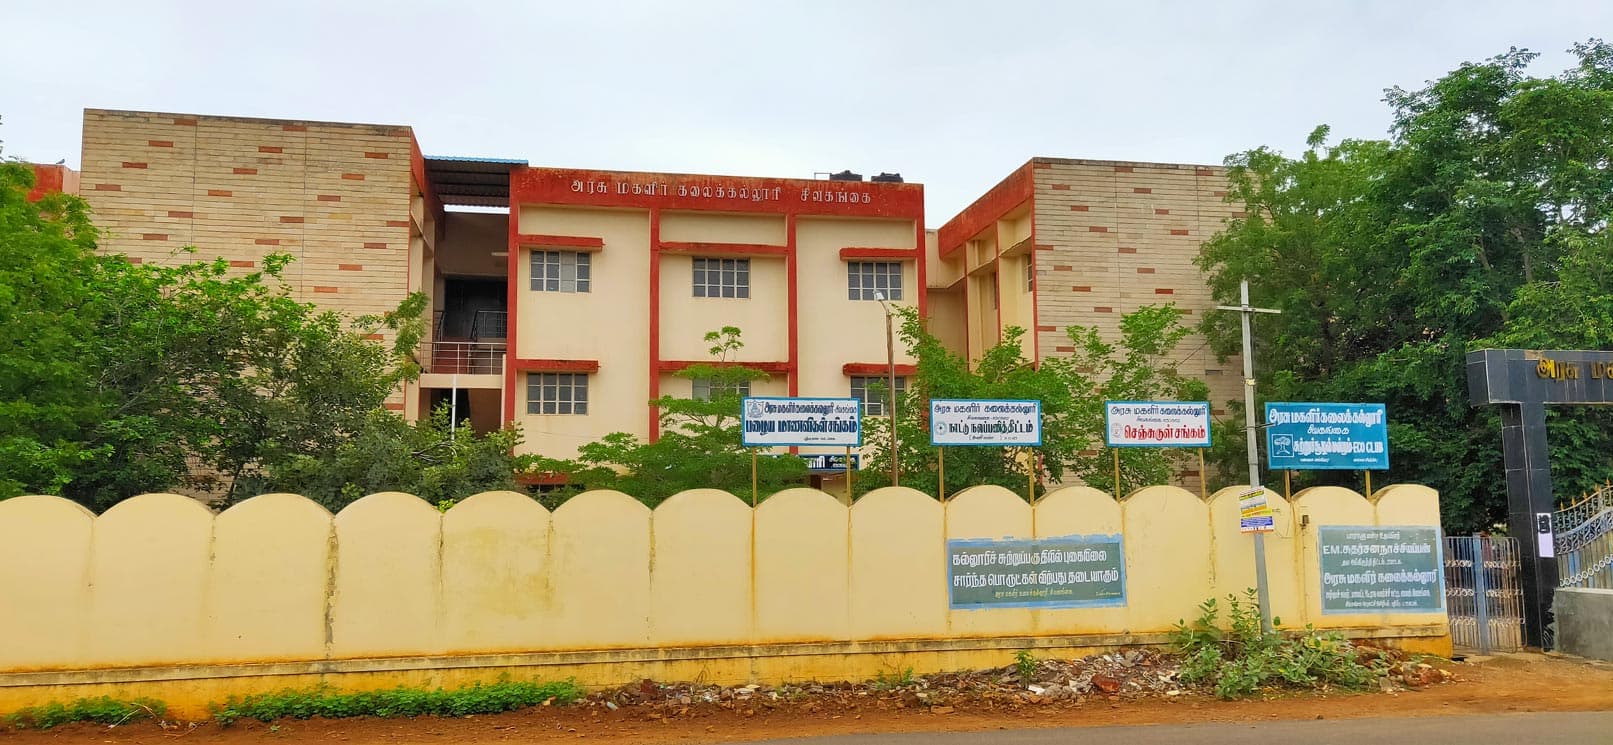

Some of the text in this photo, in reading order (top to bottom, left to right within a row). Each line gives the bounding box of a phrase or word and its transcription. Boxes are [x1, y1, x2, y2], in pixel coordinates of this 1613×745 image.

[616, 180, 668, 196] மகளிர்
[677, 183, 782, 202] கலைக்கல்லூரி
[800, 186, 872, 205] சிவகங்கை
[954, 402, 981, 413] மகளிர்
[984, 402, 1037, 416] கலைக்கல்லூரி
